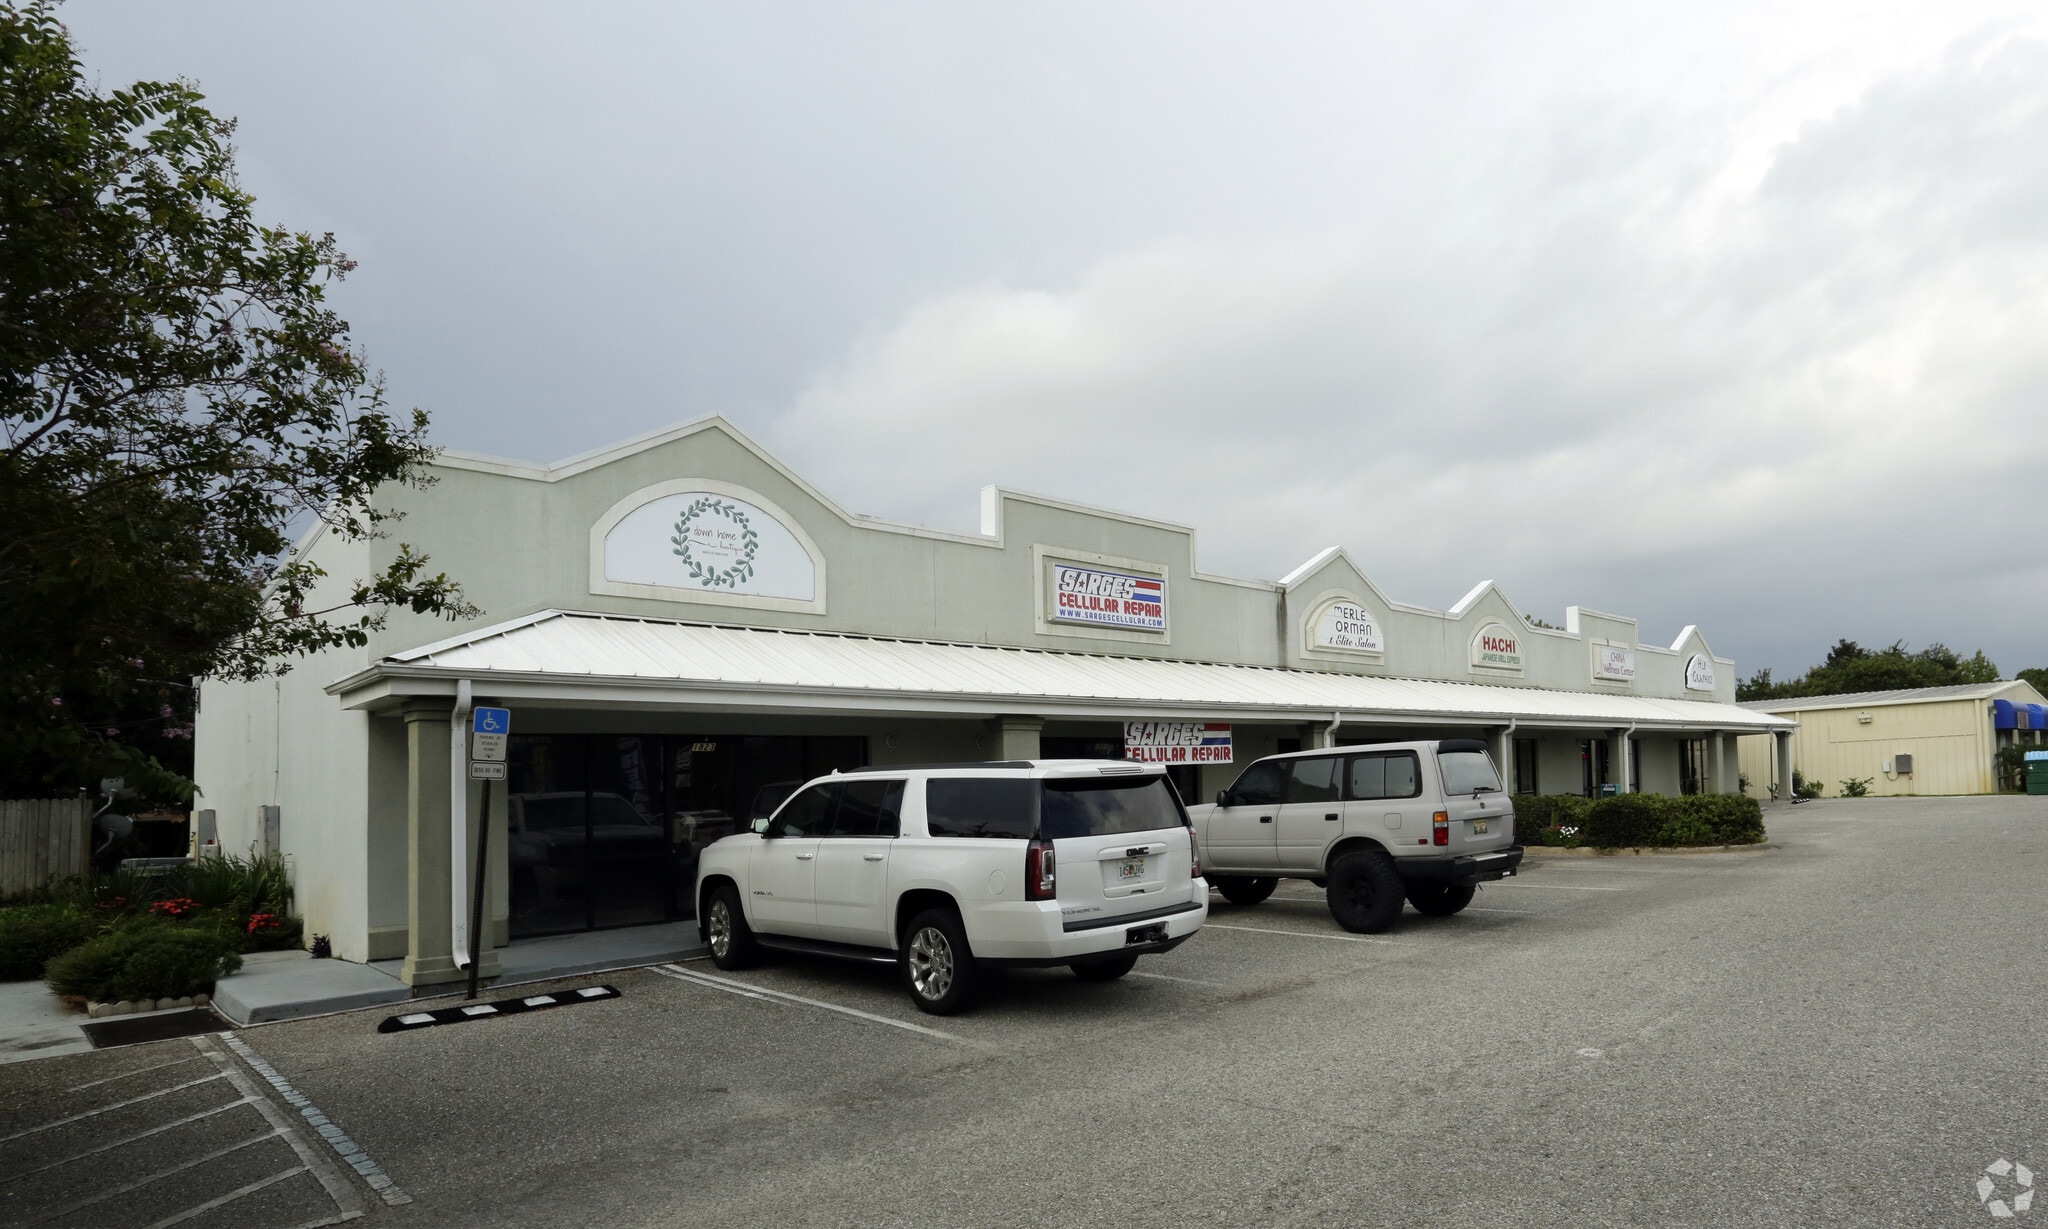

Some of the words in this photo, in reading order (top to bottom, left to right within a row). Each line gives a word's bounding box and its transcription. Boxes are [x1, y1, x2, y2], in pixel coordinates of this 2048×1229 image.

[694, 525, 713, 537] down
[717, 530, 737, 541] home
[1060, 570, 1136, 599] SARGES
[1059, 592, 1119, 613] CELLULAR
[1124, 600, 1162, 618] REPAIR
[1059, 608, 1163, 627] WWW.SARGESCELLULAR.COM
[1336, 634, 1353, 647] Elite
[1355, 637, 1376, 649] Salon
[1483, 636, 1516, 653] HACHI
[1611, 652, 1625, 664] CHINA
[1126, 722, 1205, 746] SARGES
[694, 743, 715, 751] 1823
[1125, 747, 1186, 762] CELLULAR
[1192, 746, 1231, 761] REPAIR
[1126, 847, 1149, 857] GMC
